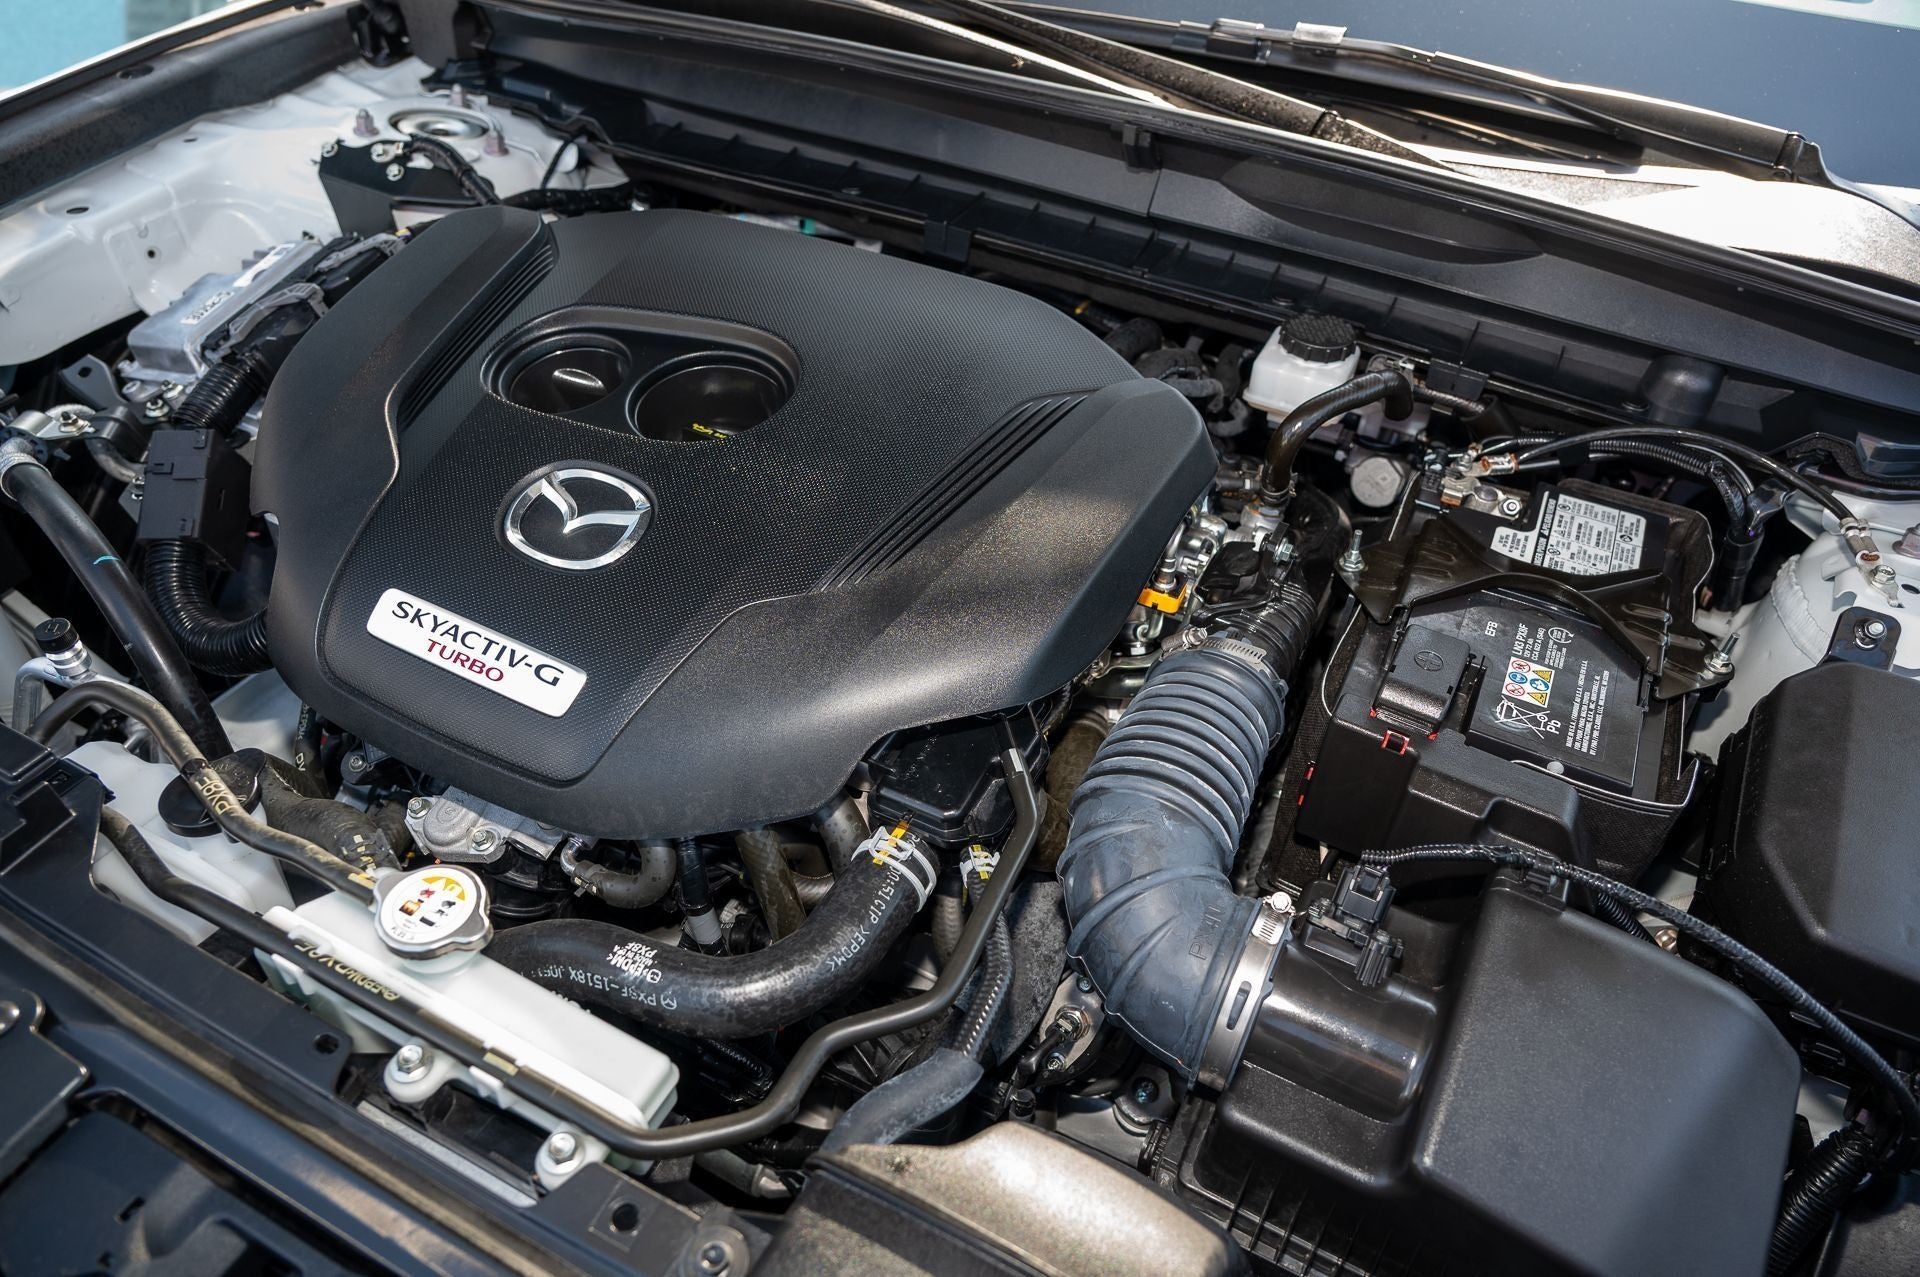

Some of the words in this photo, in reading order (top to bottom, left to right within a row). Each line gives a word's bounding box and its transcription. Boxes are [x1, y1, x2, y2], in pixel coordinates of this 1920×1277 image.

[1485, 621, 1498, 637] EFB
[392, 601, 564, 687] SKYACTIV-G
[1512, 640, 1524, 655] LN3
[427, 638, 504, 682] TURBO
[1546, 719, 1561, 735] Pb
[195, 776, 240, 815] PX8F
[626, 941, 657, 958] PX8F
